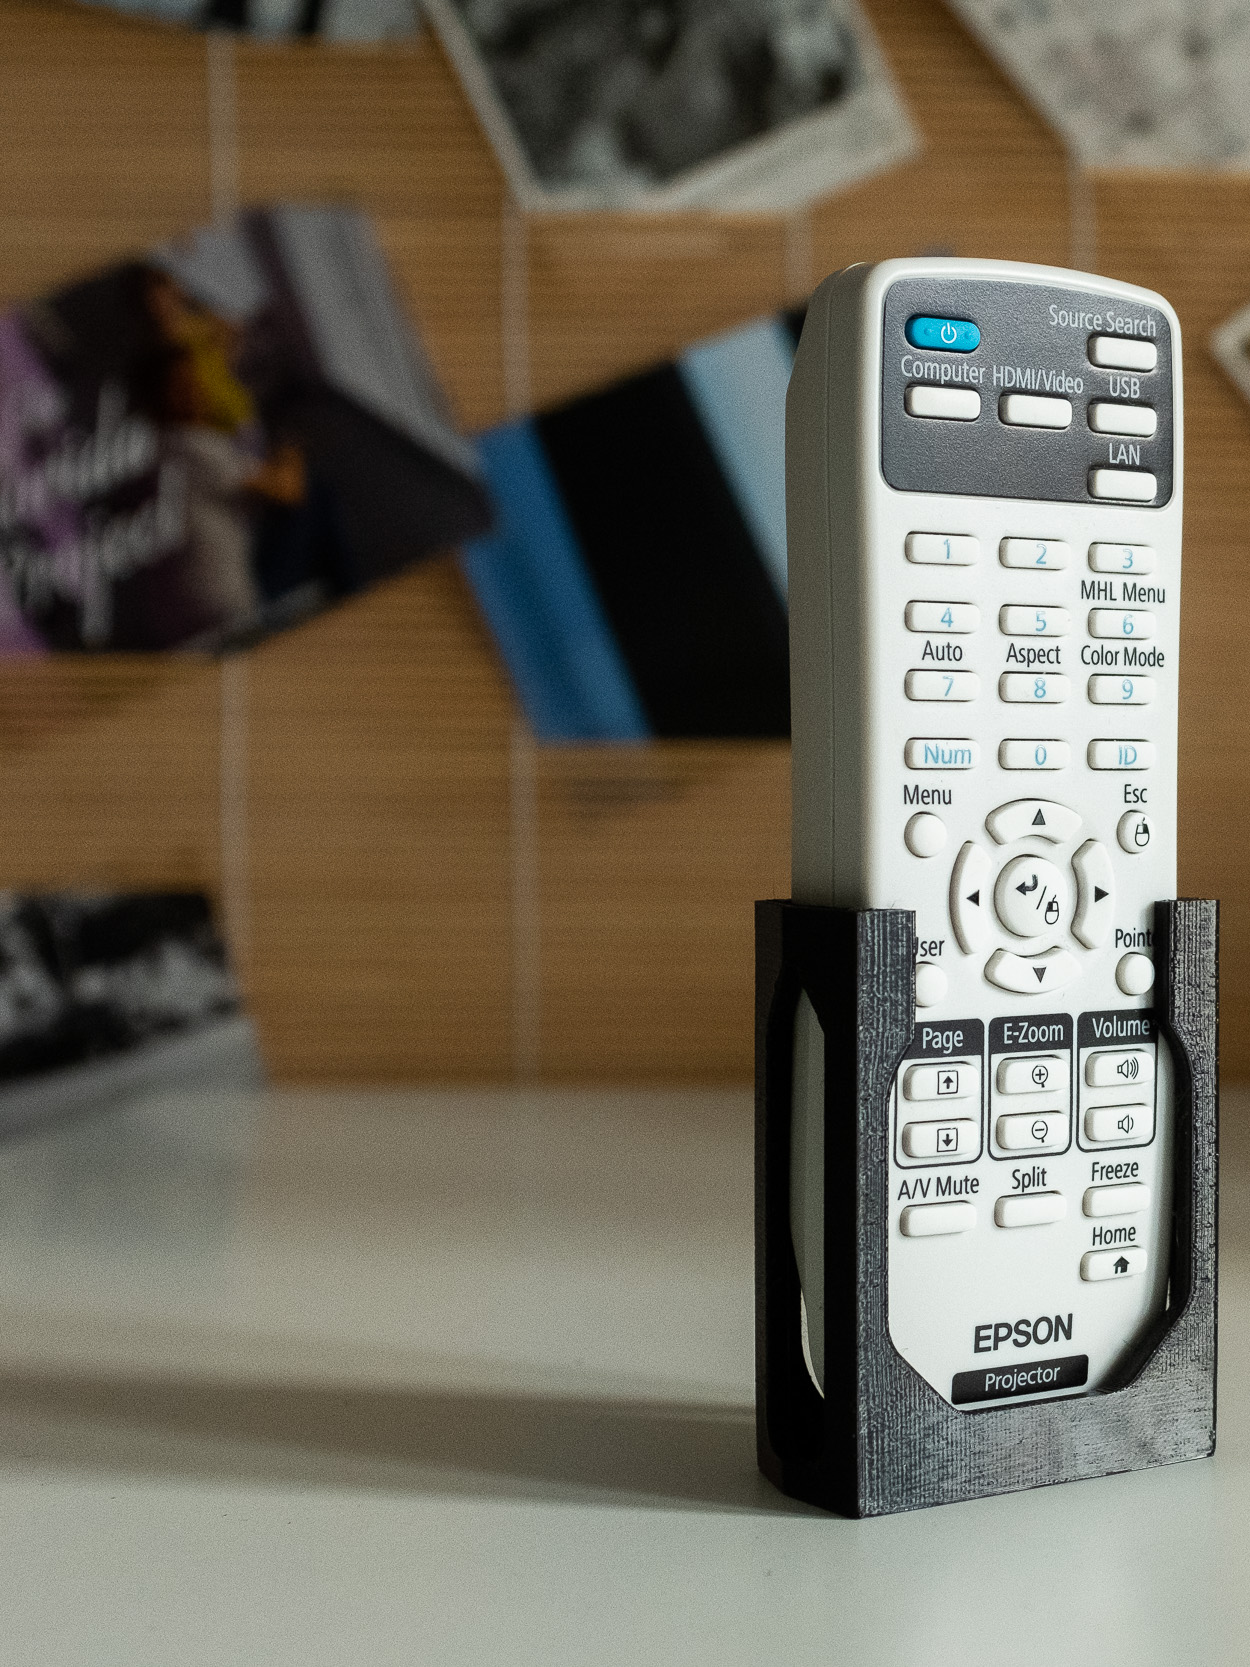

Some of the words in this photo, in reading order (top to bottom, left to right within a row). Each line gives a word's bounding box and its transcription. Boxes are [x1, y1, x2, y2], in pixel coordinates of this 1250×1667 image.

[1049, 305, 1102, 330] Source
[1106, 310, 1156, 337] Search
[901, 355, 986, 384] Computer
[993, 366, 1084, 394] HDMI/Video
[1109, 376, 1140, 399] USB
[1109, 443, 1140, 466] LAN
[943, 539, 951, 560] 1
[1036, 543, 1047, 565] 2
[1122, 548, 1134, 569] 3
[1081, 580, 1117, 601] MHL
[1122, 582, 1166, 604] Menu
[940, 607, 954, 628] 4
[1035, 610, 1047, 632] 5
[1122, 614, 1134, 635] 6
[921, 640, 963, 662] Auto
[1006, 642, 1061, 668] Aspect
[1081, 645, 1119, 666] Color
[1123, 646, 1165, 668] Mode
[942, 676, 954, 697] 7
[1034, 677, 1047, 699] 8
[1122, 679, 1134, 700] 9
[924, 743, 972, 765] Num
[1118, 745, 1138, 765] ID
[903, 784, 952, 805] Menu
[1124, 783, 1148, 804] Esc
[1003, 1022, 1064, 1045] E-Zoom
[1092, 1015, 1151, 1038] Volume
[922, 1027, 964, 1053] Page
[1012, 1166, 1047, 1192] Split
[1091, 1160, 1139, 1182] Freeze
[898, 1176, 932, 1201] A/V
[936, 1175, 980, 1197] Mute
[1092, 1224, 1136, 1246] Home
[973, 1313, 1073, 1353] EPSON
[985, 1364, 1060, 1392] Projector
